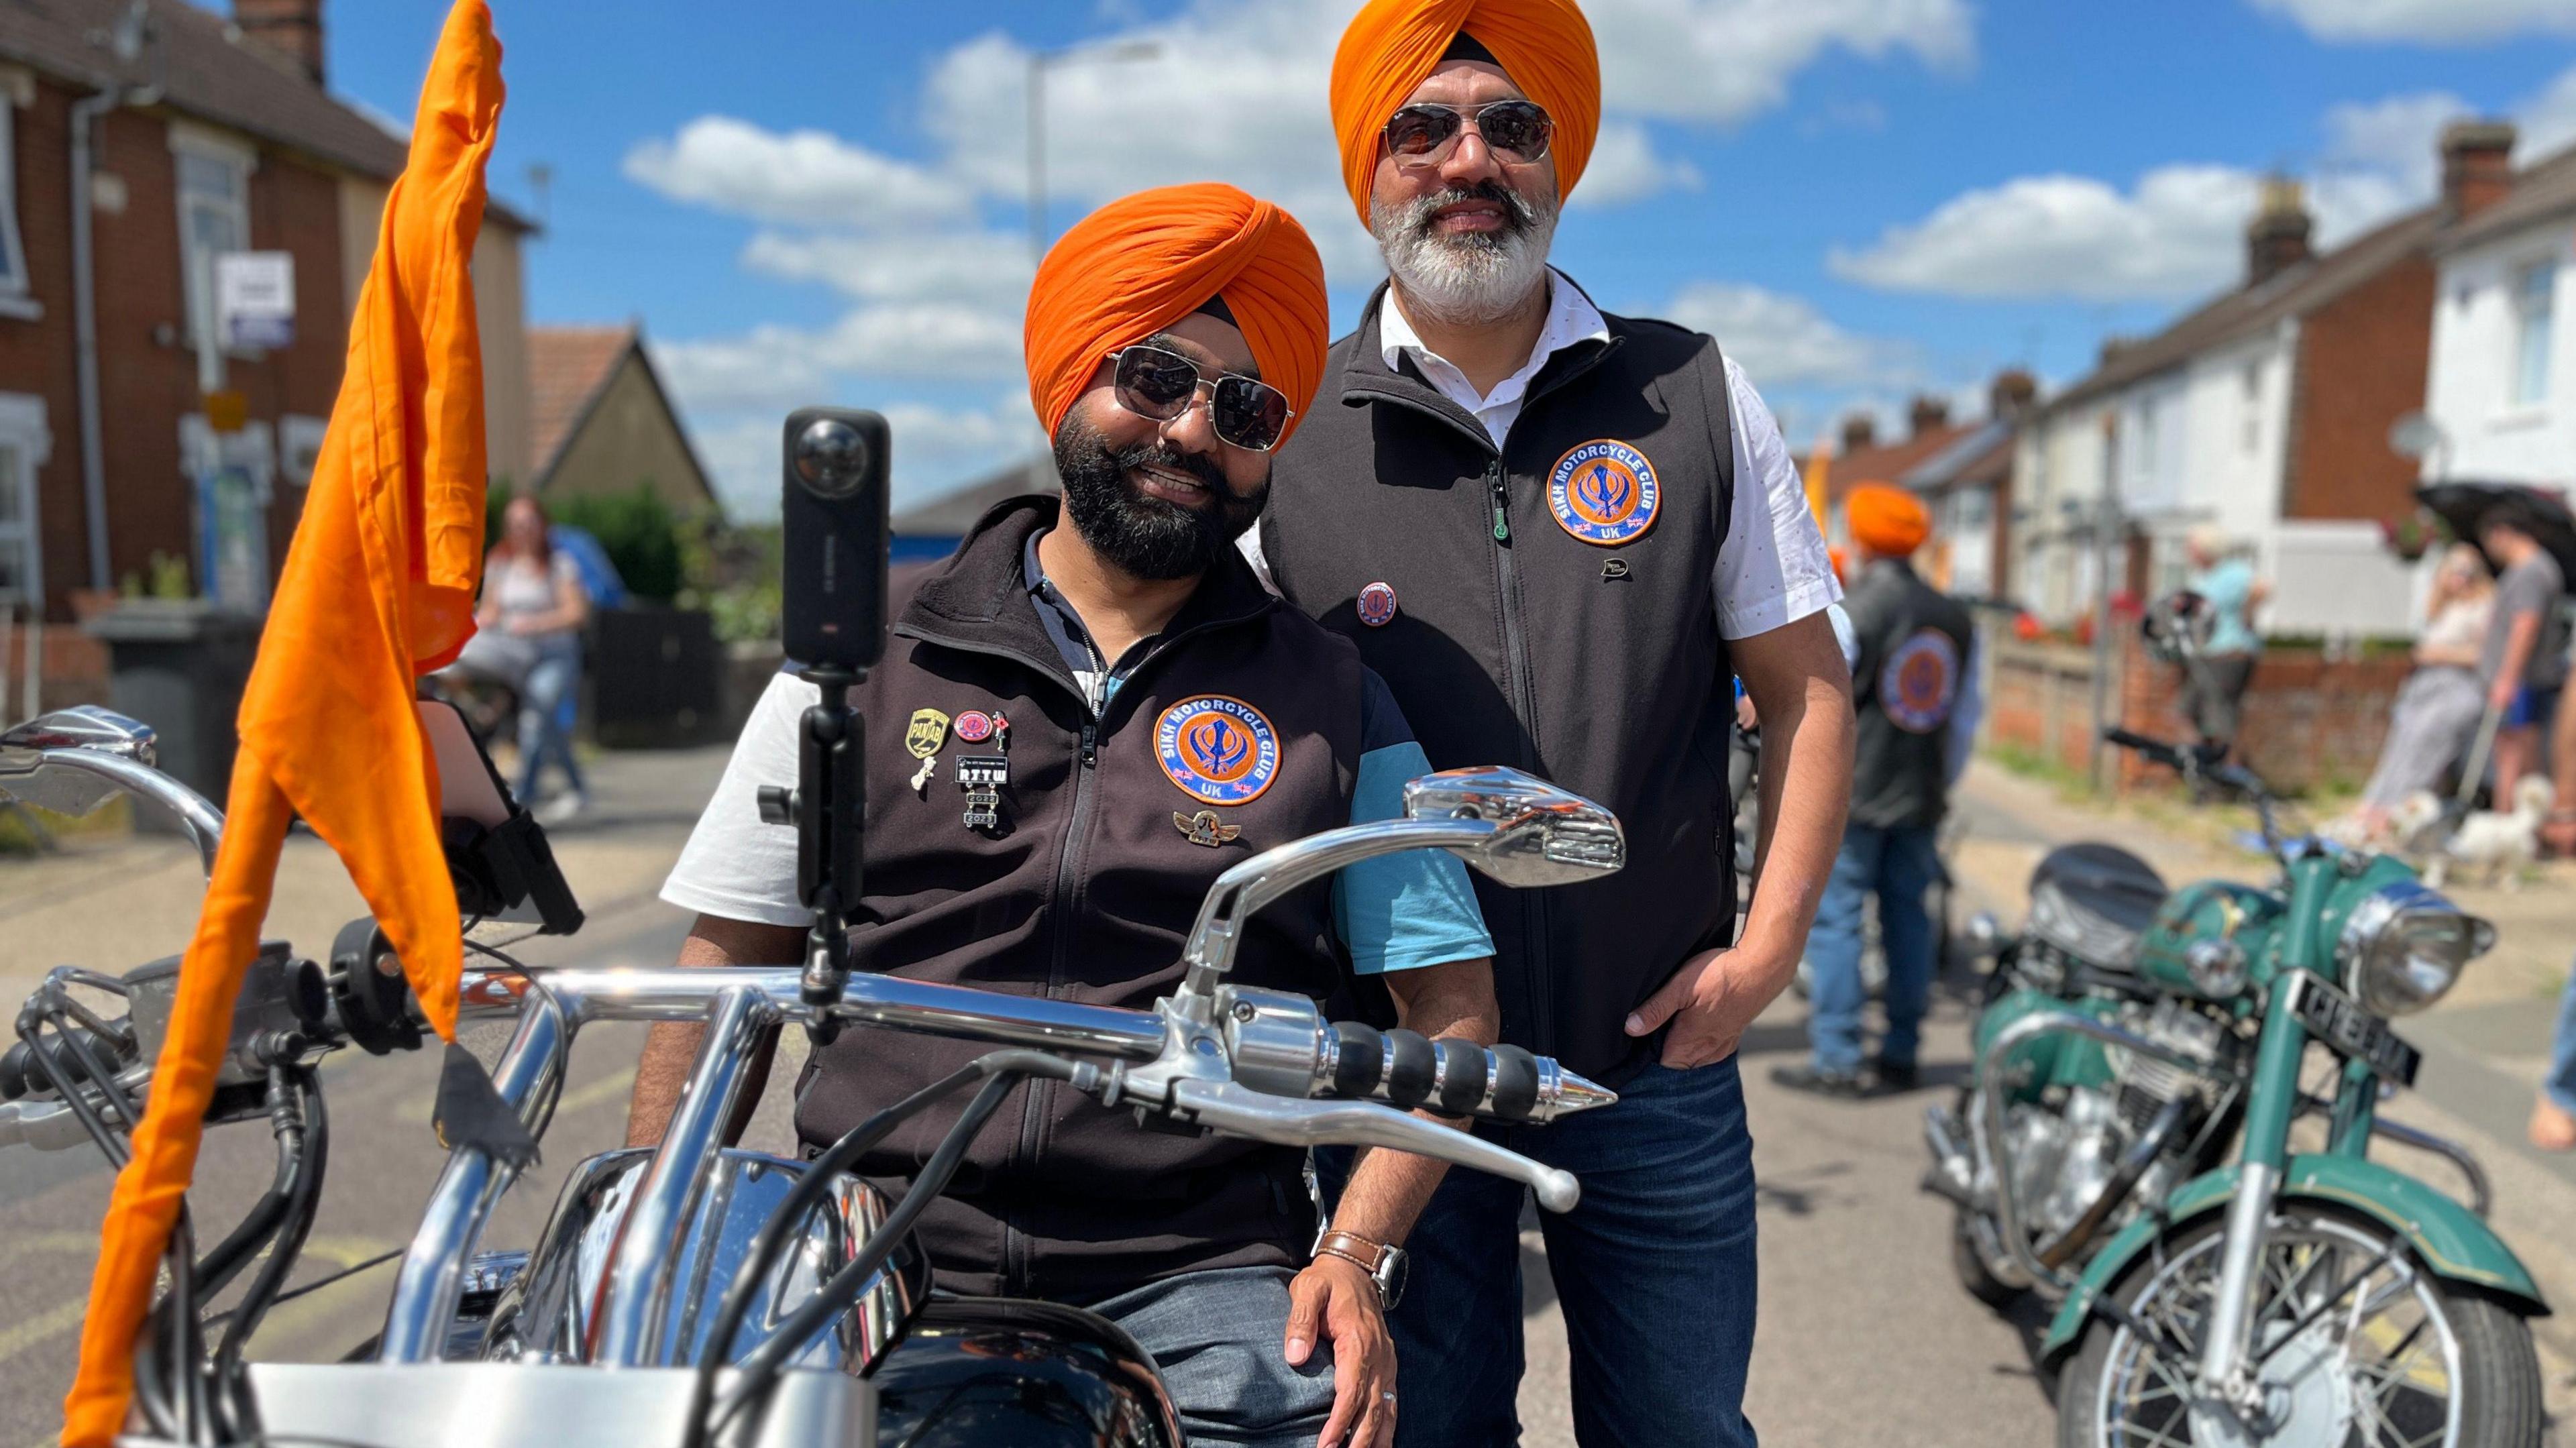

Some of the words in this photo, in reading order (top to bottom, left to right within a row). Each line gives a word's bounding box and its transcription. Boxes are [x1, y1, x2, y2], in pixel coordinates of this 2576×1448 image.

[1555, 445, 1644, 484] MOTORCYCLE
[1552, 486, 1570, 518] SIKH
[1639, 471, 1655, 510] CLUB
[1601, 527, 1620, 539] UK
[1160, 724, 1177, 759] SIKH
[1169, 699, 1269, 737] MOTORCYCLE
[1254, 740, 1275, 780] CLUB
[1201, 783, 1222, 798] UK
